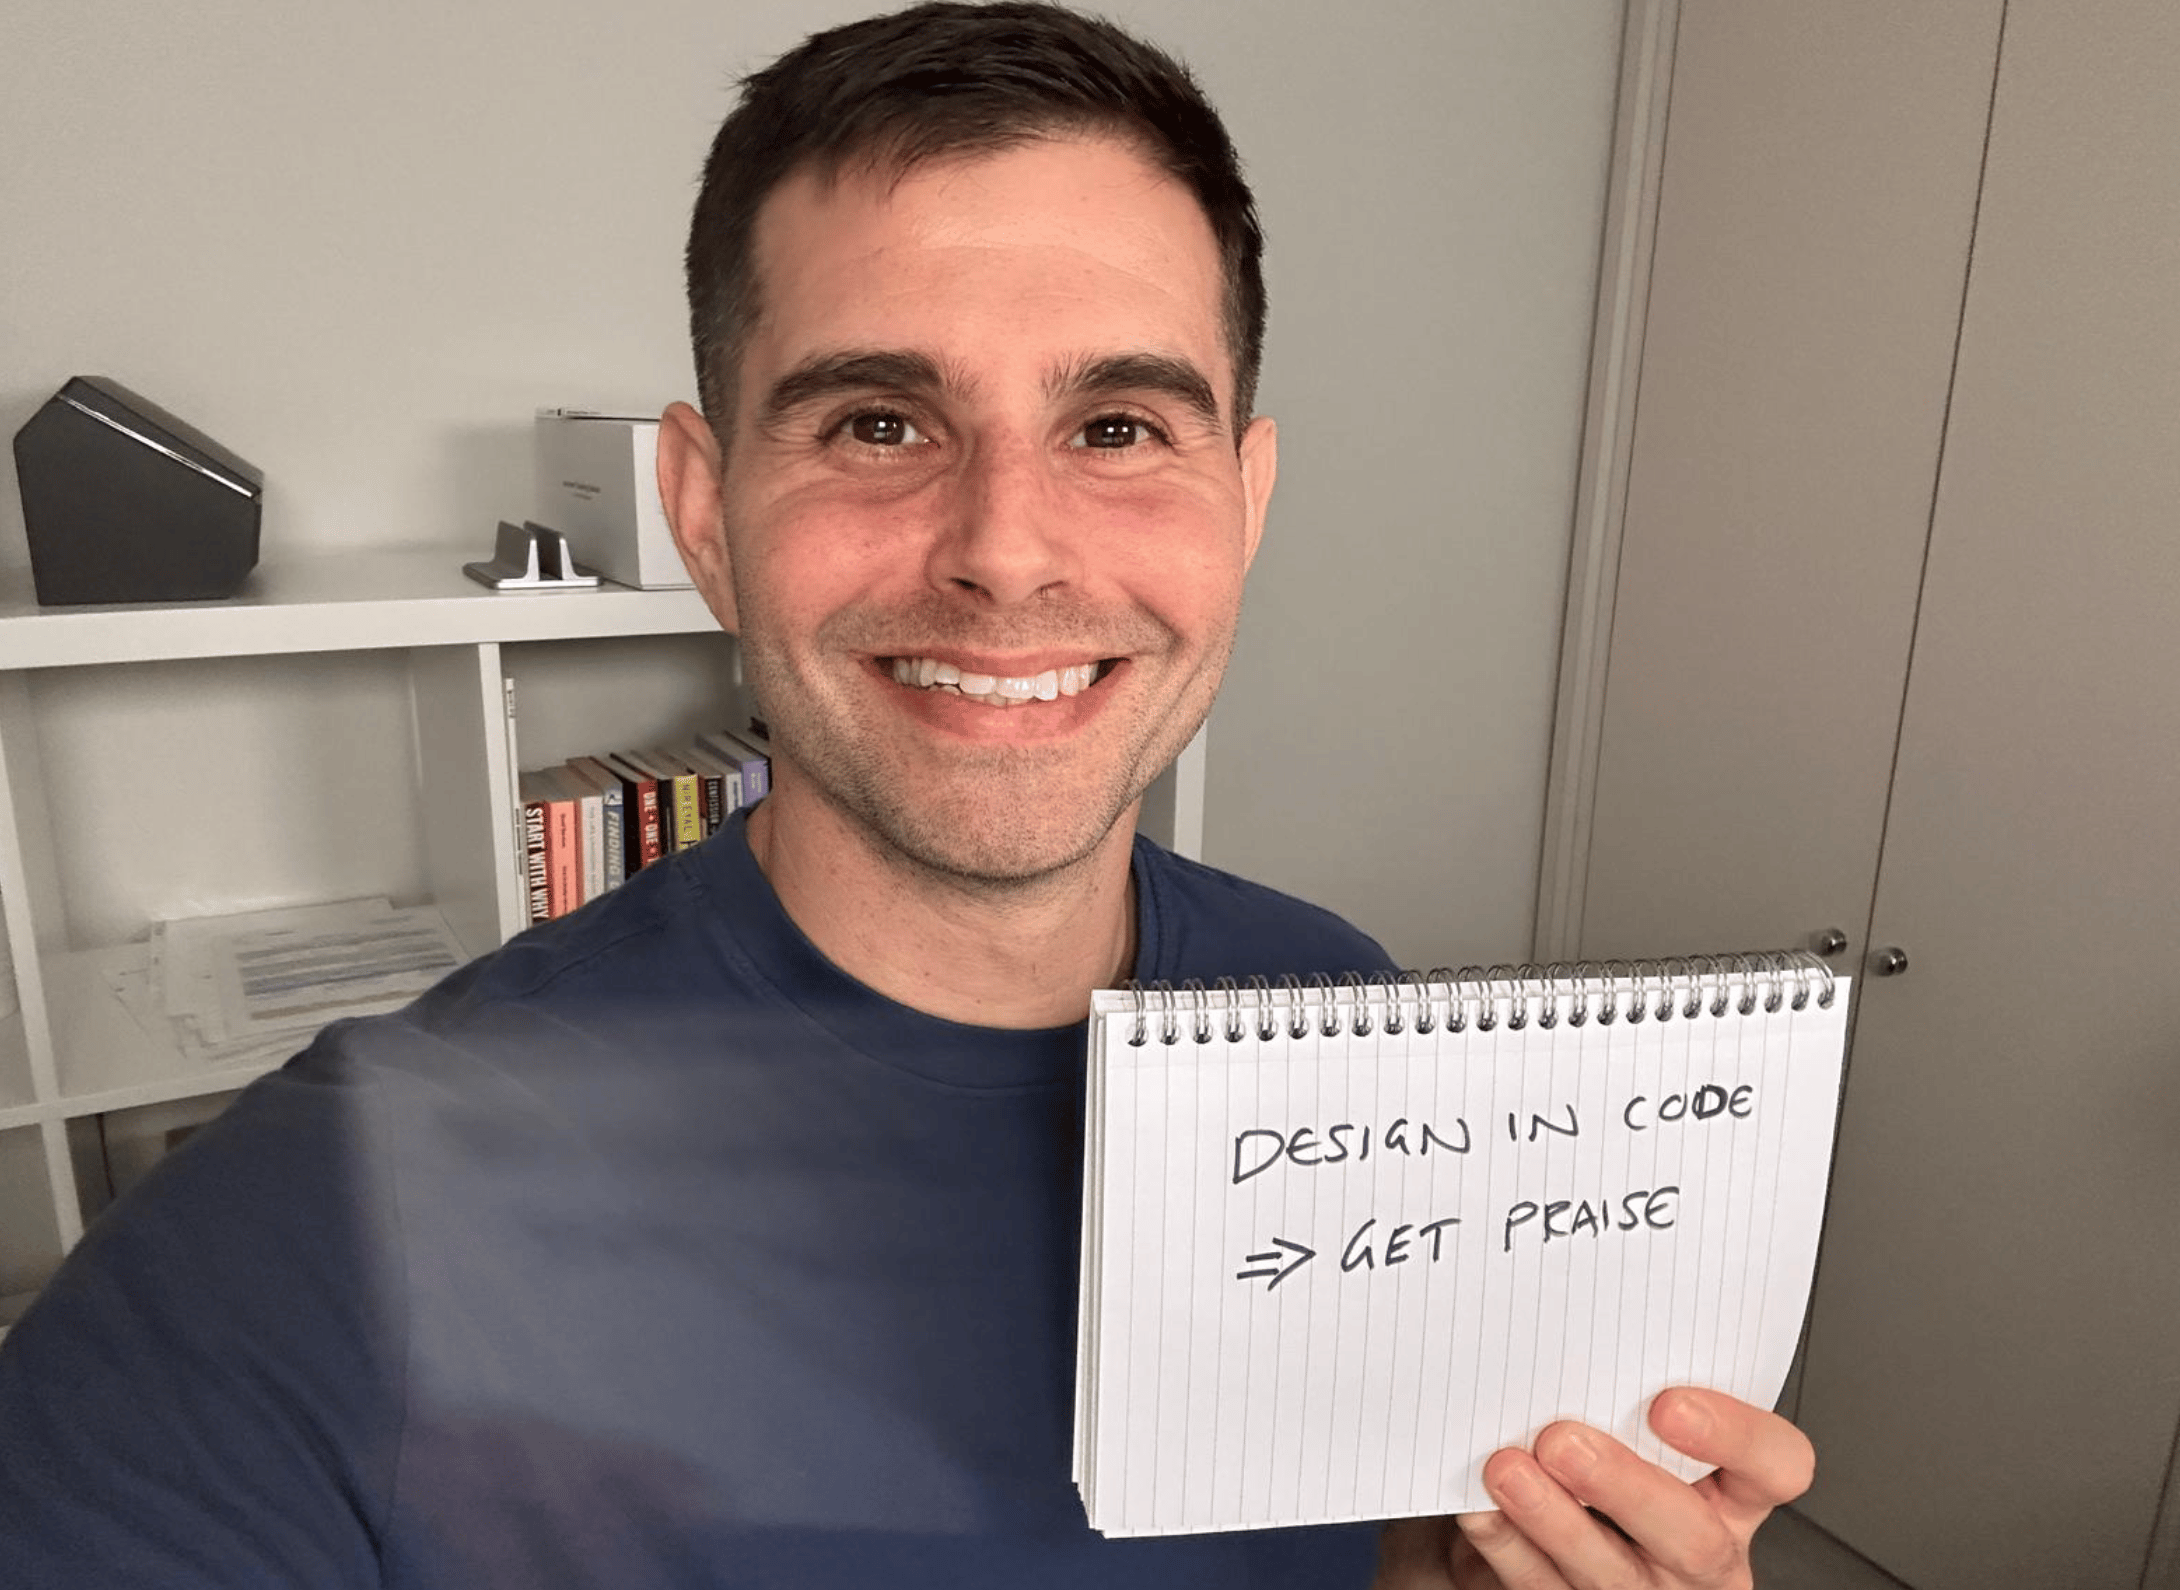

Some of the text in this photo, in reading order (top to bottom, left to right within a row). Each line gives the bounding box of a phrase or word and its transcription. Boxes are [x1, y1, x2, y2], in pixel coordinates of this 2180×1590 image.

[525, 807, 549, 919] START WITH WHY
[607, 811, 621, 875] FINDING
[1232, 1083, 1755, 1185] DESIGN IN CODE
[1340, 1186, 1681, 1273] GET PRAISE
